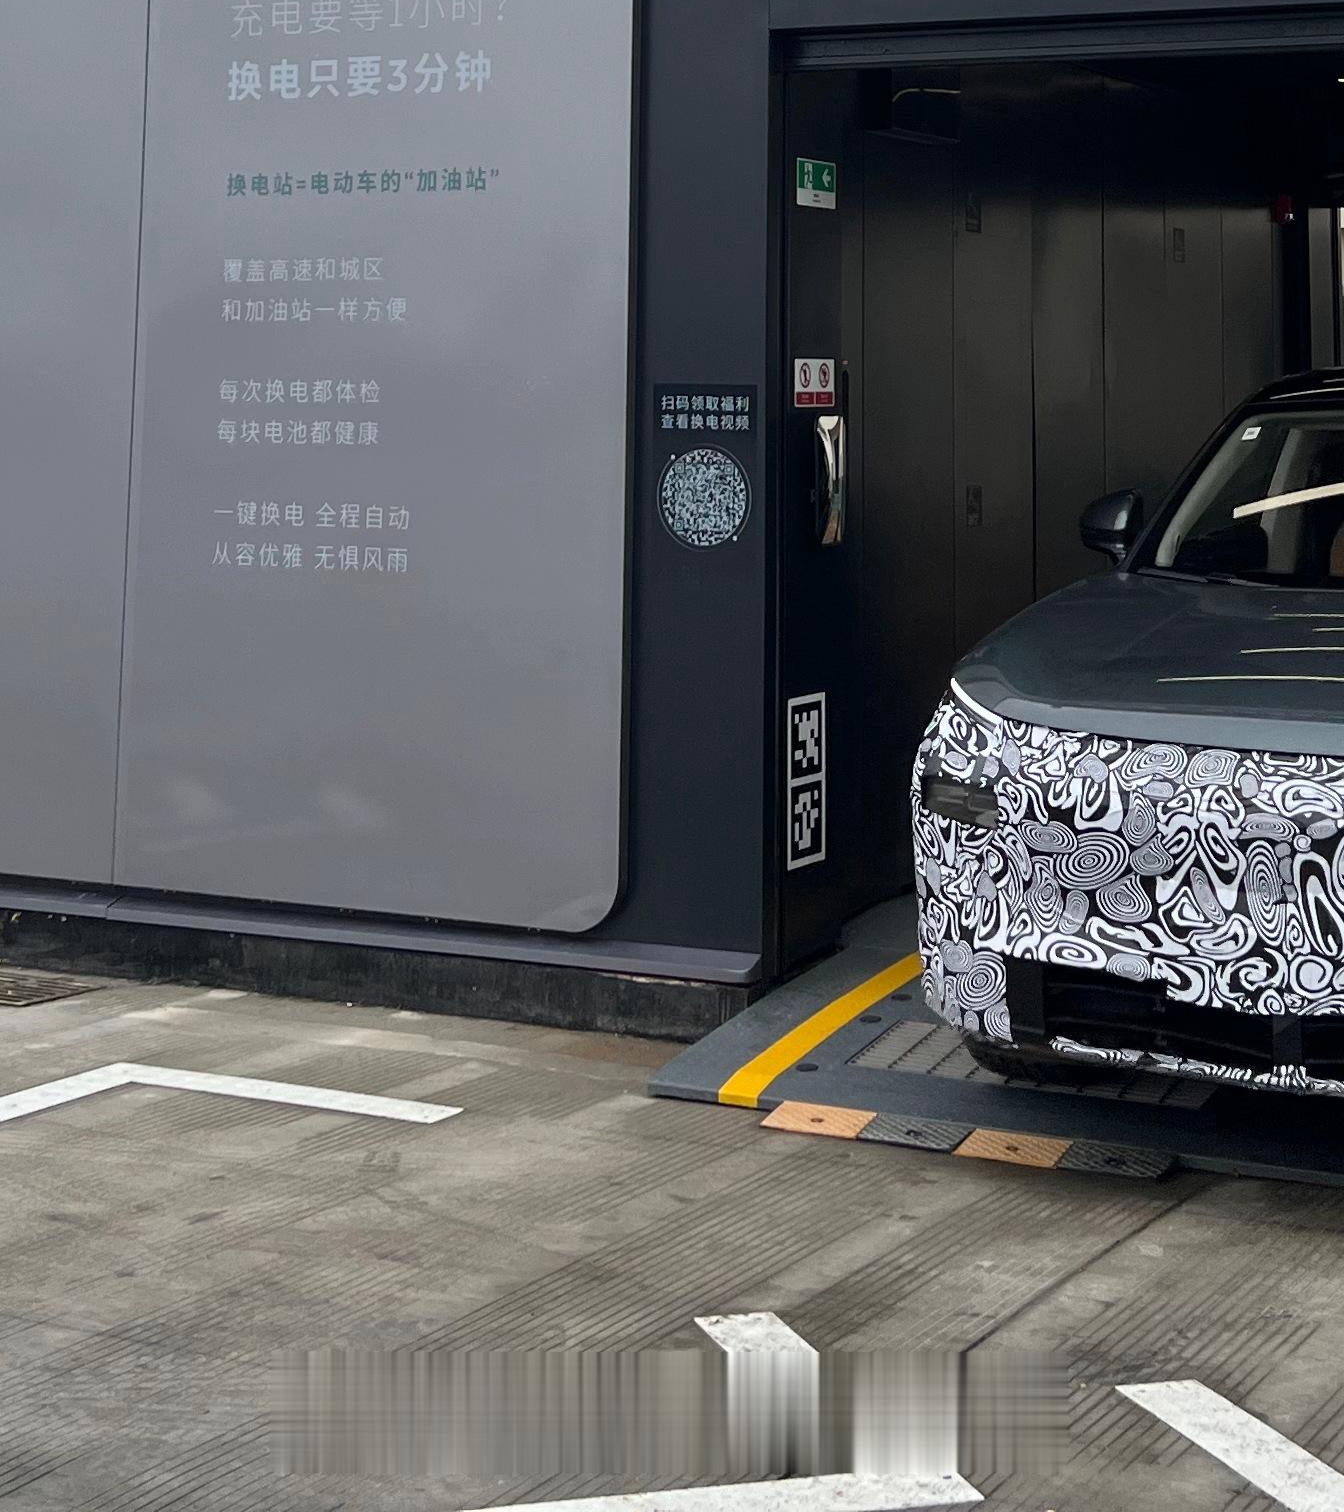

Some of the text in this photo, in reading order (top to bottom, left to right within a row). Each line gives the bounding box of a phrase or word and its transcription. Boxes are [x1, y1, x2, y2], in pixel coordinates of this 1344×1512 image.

[227, 49, 491, 102] 换电只要3分钟
[223, 257, 384, 283] 覆盖高速和城区
[221, 297, 407, 322] 和加油站一样方便
[218, 378, 381, 404] 每次换电都体检
[661, 394, 750, 413] 扫码领取福利
[217, 419, 380, 445] 每块电池都健康
[661, 413, 751, 431] 查看换电视频
[213, 501, 410, 530] 一键换电 全程自动
[211, 541, 409, 573] 从容优雅 无惧风雨
